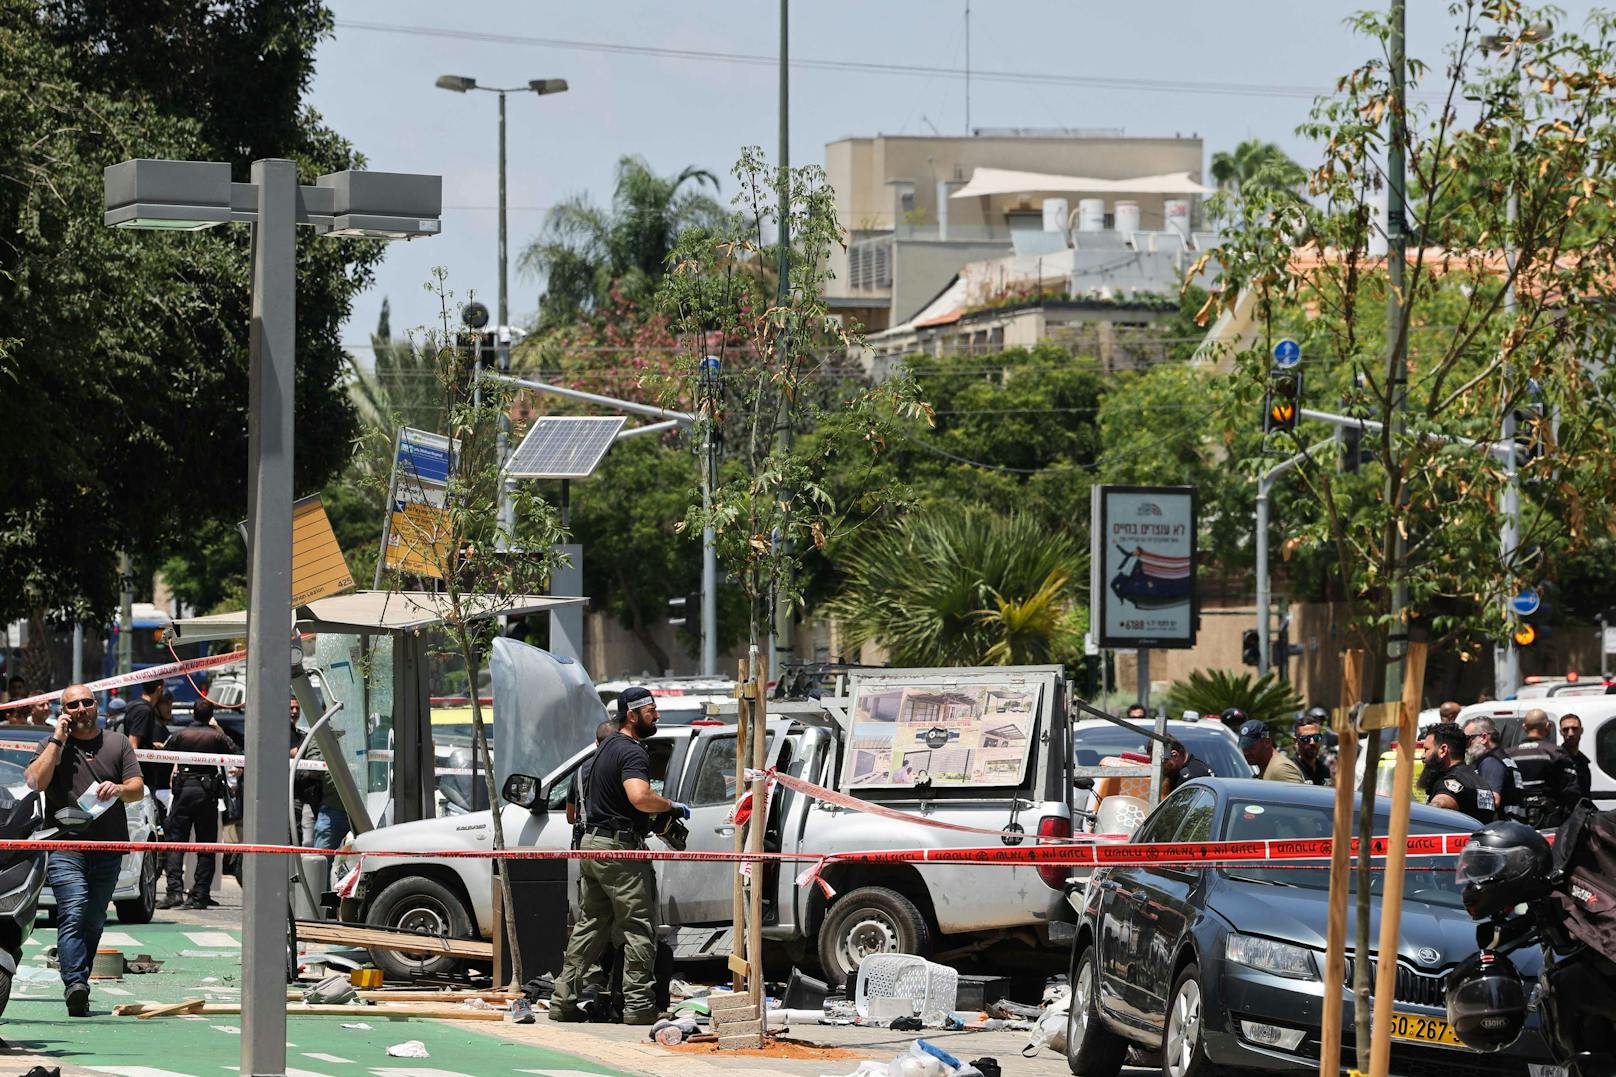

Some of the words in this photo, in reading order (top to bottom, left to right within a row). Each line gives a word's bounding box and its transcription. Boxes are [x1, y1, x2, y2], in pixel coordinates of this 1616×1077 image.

[1113, 523, 1137, 535] בחיים
[1141, 523, 1170, 535] עוצרים
[1173, 523, 1185, 536] לא
[338, 576, 352, 587] 425
[307, 586, 325, 597] Lezion
[1104, 847, 1142, 857] משטרת
[1163, 846, 1195, 858] ישראל
[1214, 844, 1228, 854] אין
[1231, 845, 1259, 855] מעבר
[1277, 843, 1316, 853] משטרת
[935, 850, 973, 861] משטרת
[993, 850, 1024, 861] ישראל
[1042, 848, 1056, 859] אין
[1059, 849, 1086, 858] מעבר
